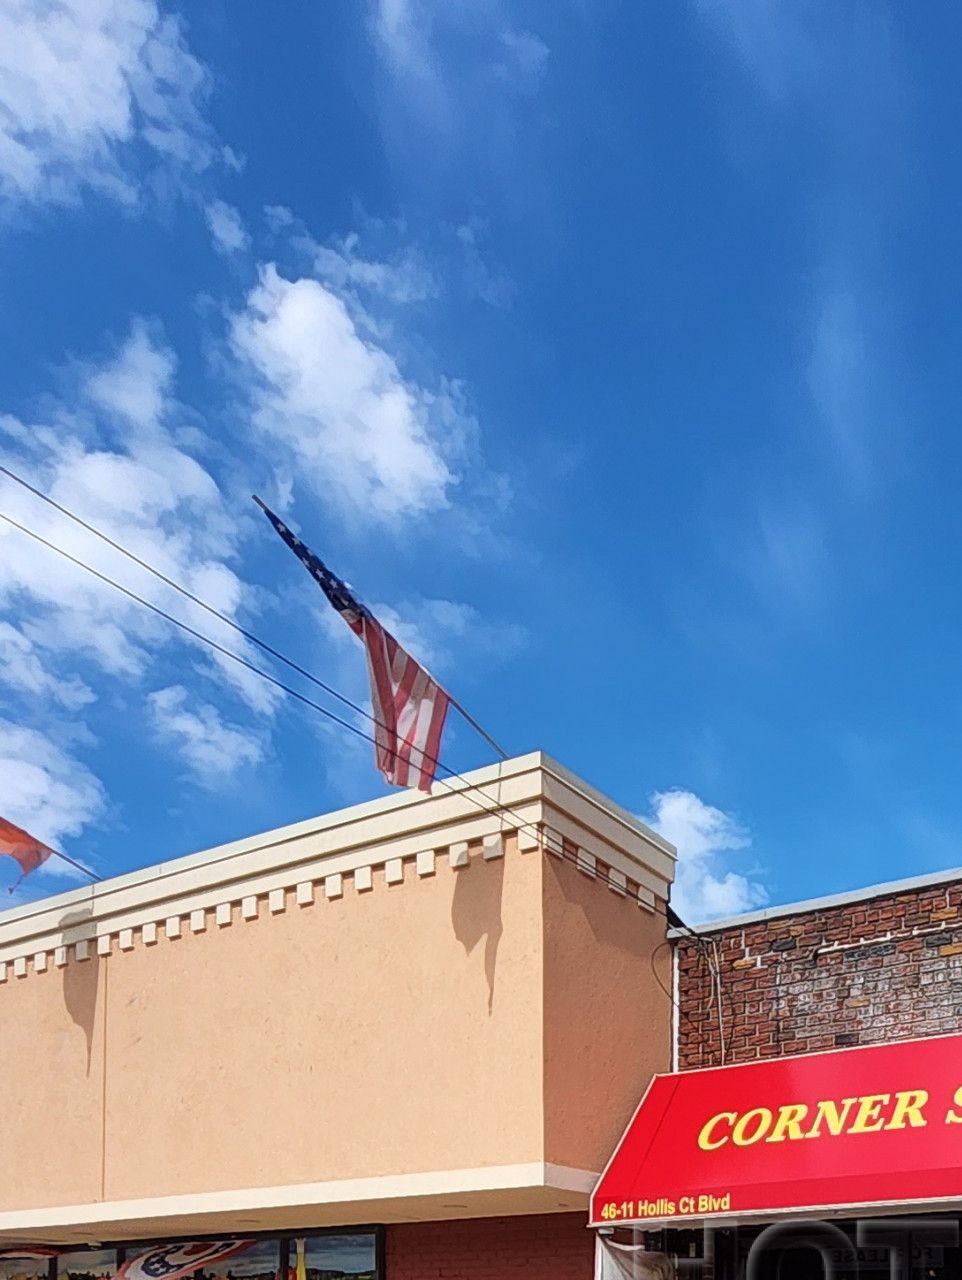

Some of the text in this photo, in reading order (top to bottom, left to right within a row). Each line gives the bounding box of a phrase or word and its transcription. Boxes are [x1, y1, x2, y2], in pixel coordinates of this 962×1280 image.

[697, 1090, 929, 1151] CORNER
[601, 1193, 731, 1219] 46-11 Hollis Ct Blvd
